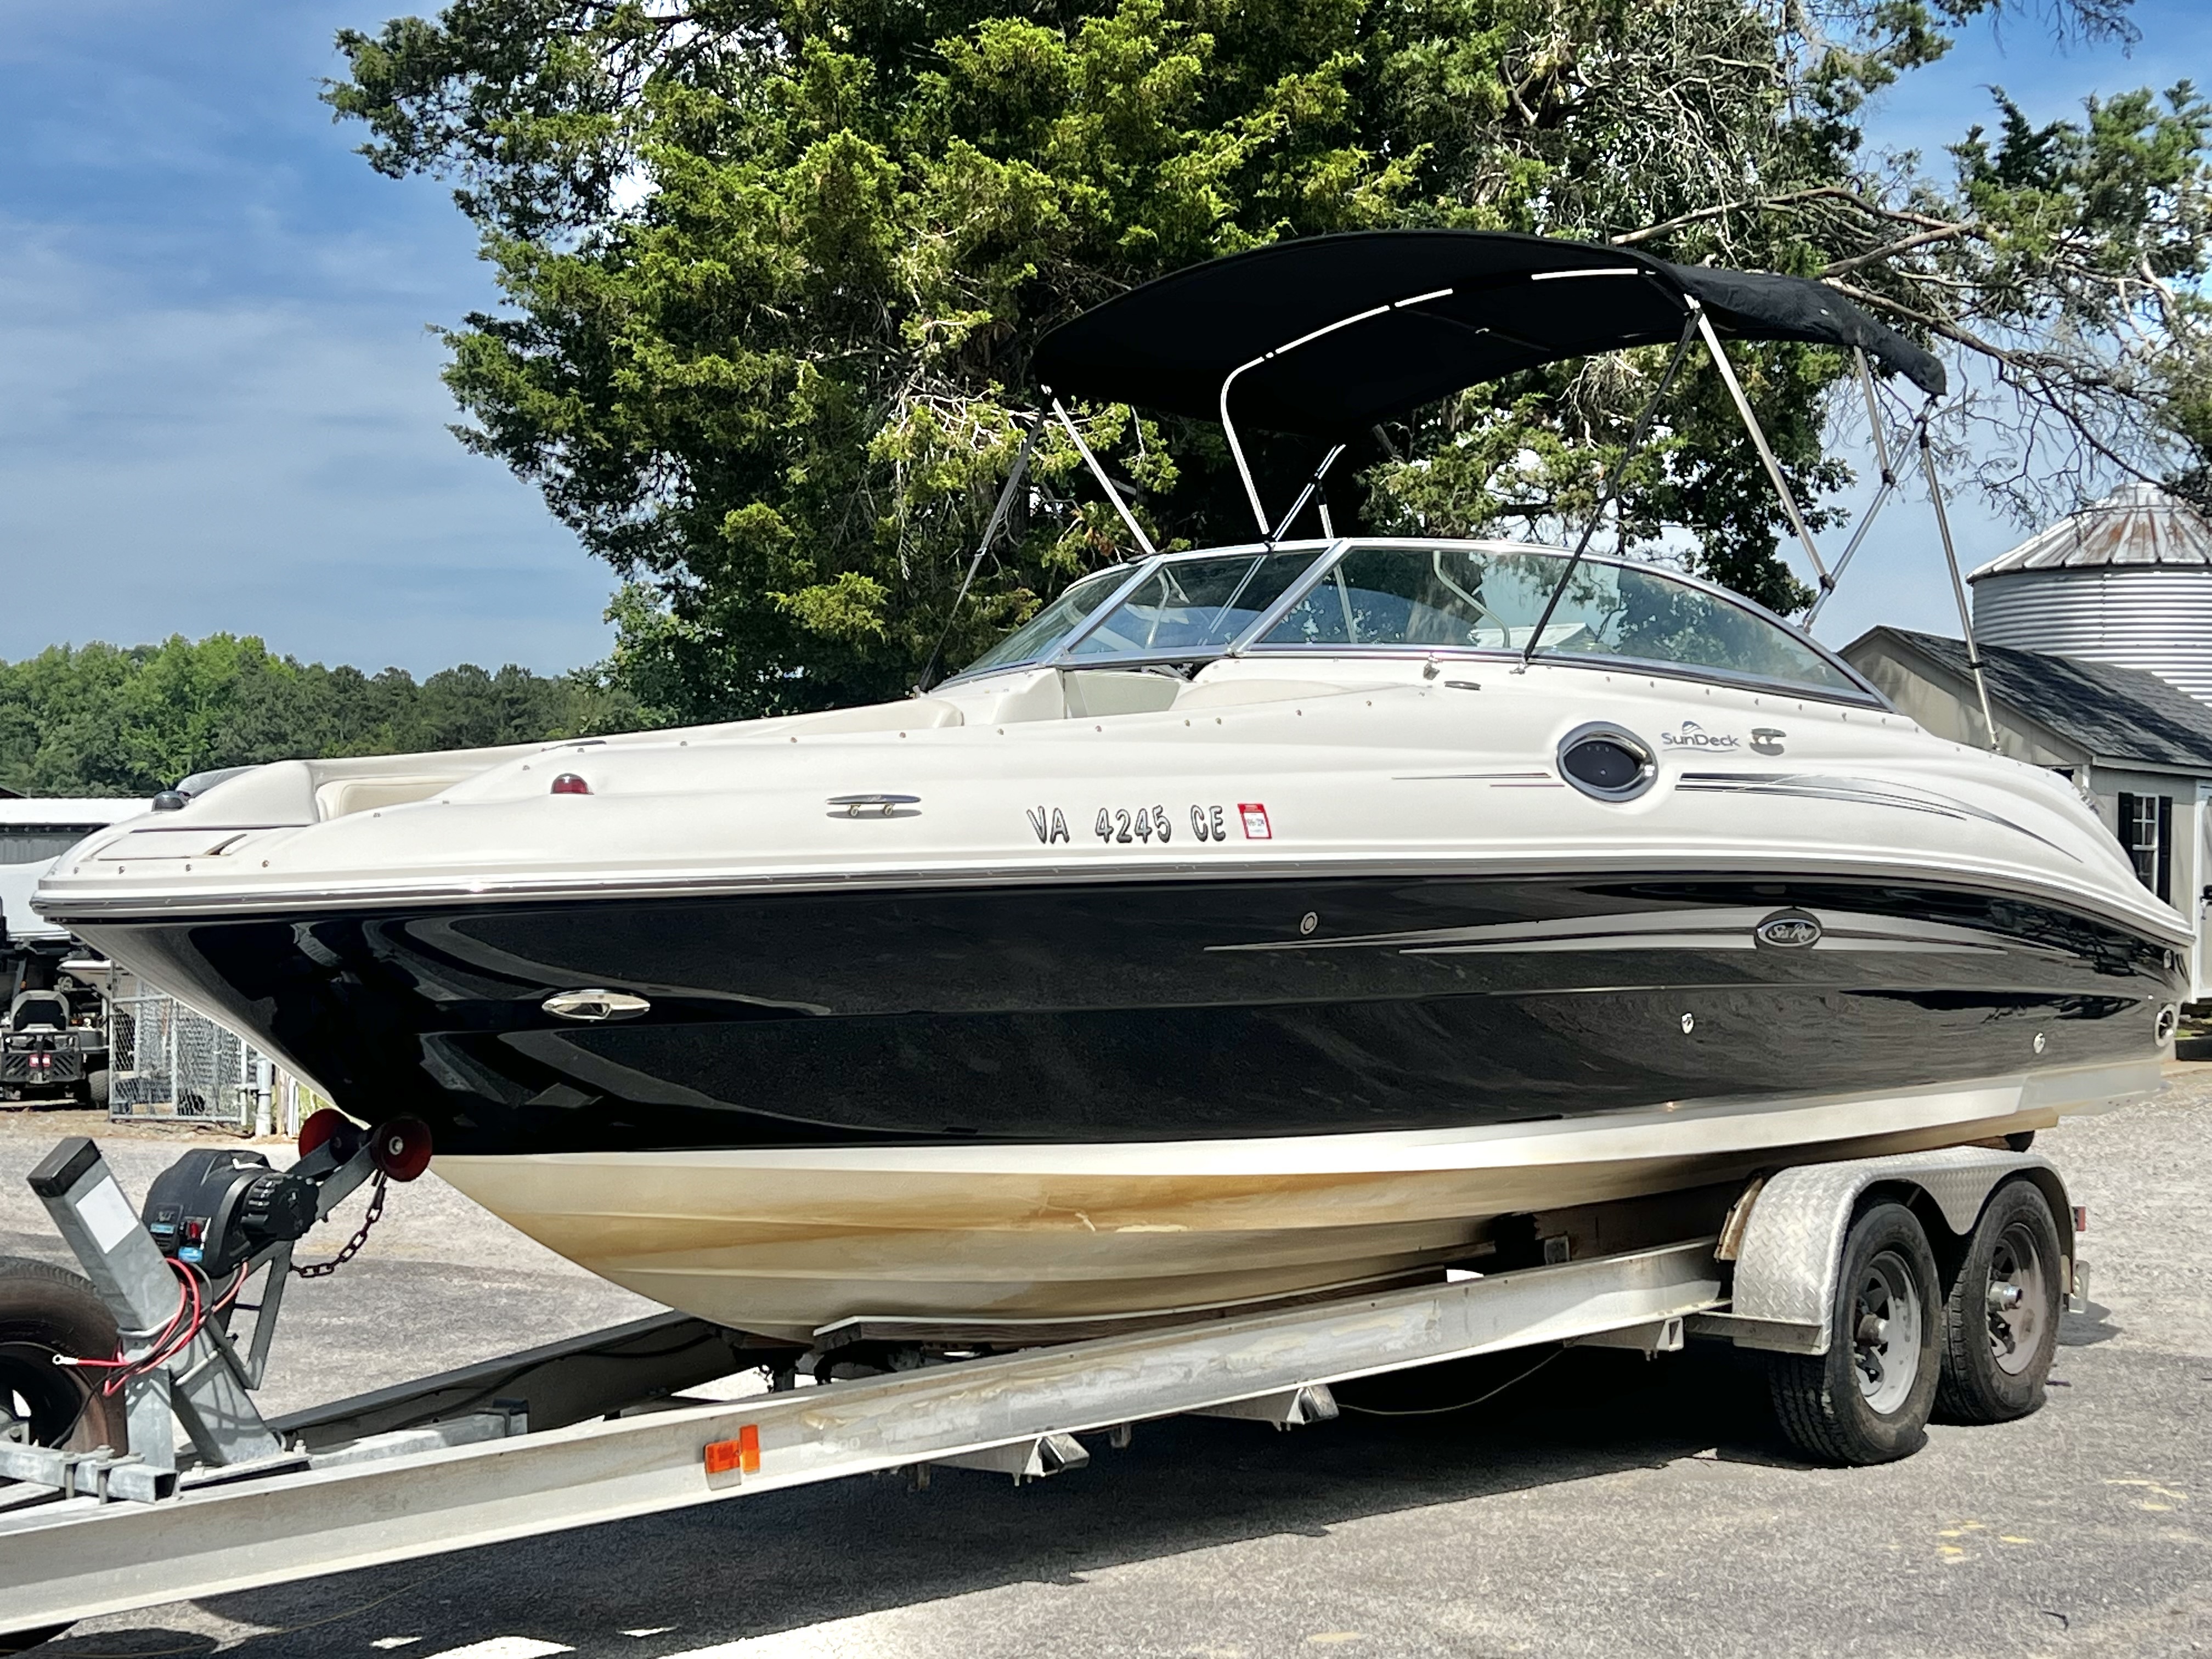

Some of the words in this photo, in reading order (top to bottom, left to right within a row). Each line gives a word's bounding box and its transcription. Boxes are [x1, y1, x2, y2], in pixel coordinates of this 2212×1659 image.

[1661, 732, 1741, 747] SunDeck
[1026, 805, 1070, 844] VA
[1095, 805, 1172, 843] 4245
[1190, 805, 1226, 842] CE
